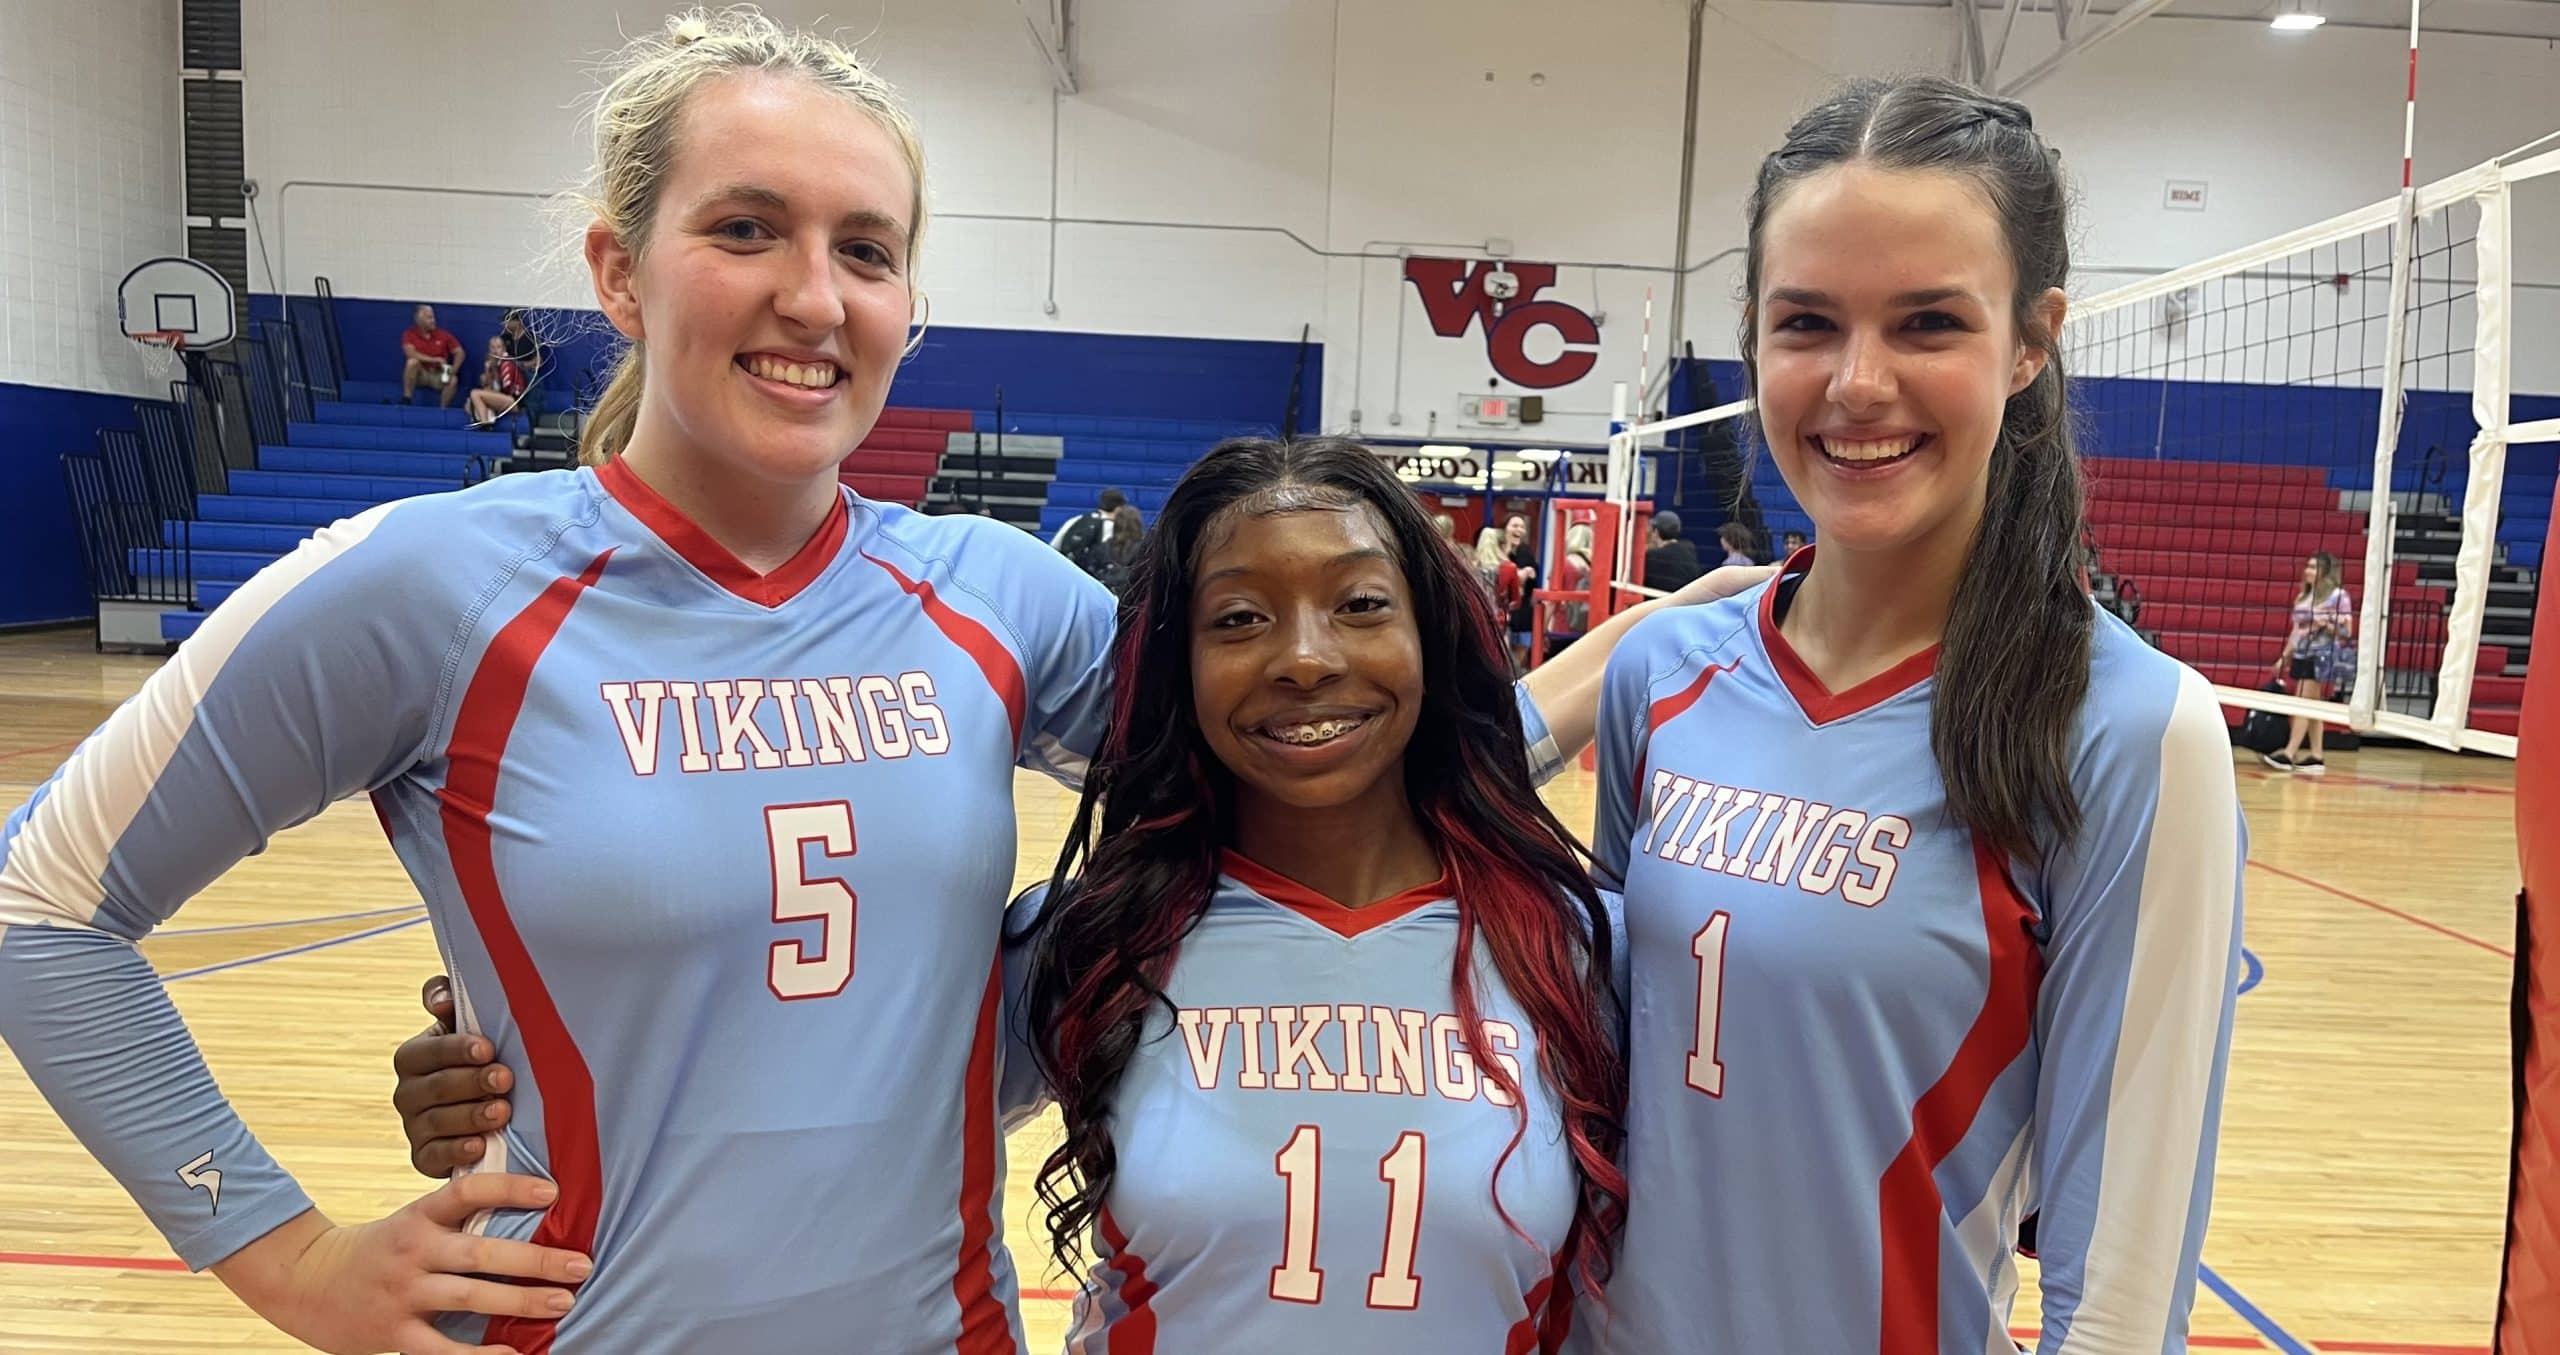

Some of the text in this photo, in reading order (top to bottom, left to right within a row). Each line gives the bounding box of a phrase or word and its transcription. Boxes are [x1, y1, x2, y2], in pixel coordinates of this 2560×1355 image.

[1405, 257, 1600, 389] WC
[600, 671, 951, 776] VIKINGS
[763, 799, 857, 1001] 5
[1643, 769, 1912, 908] VIKINGS
[1177, 1004, 1521, 1107] VIKINGS
[1685, 910, 1731, 1100] 1
[1268, 1124, 1426, 1311] 11
